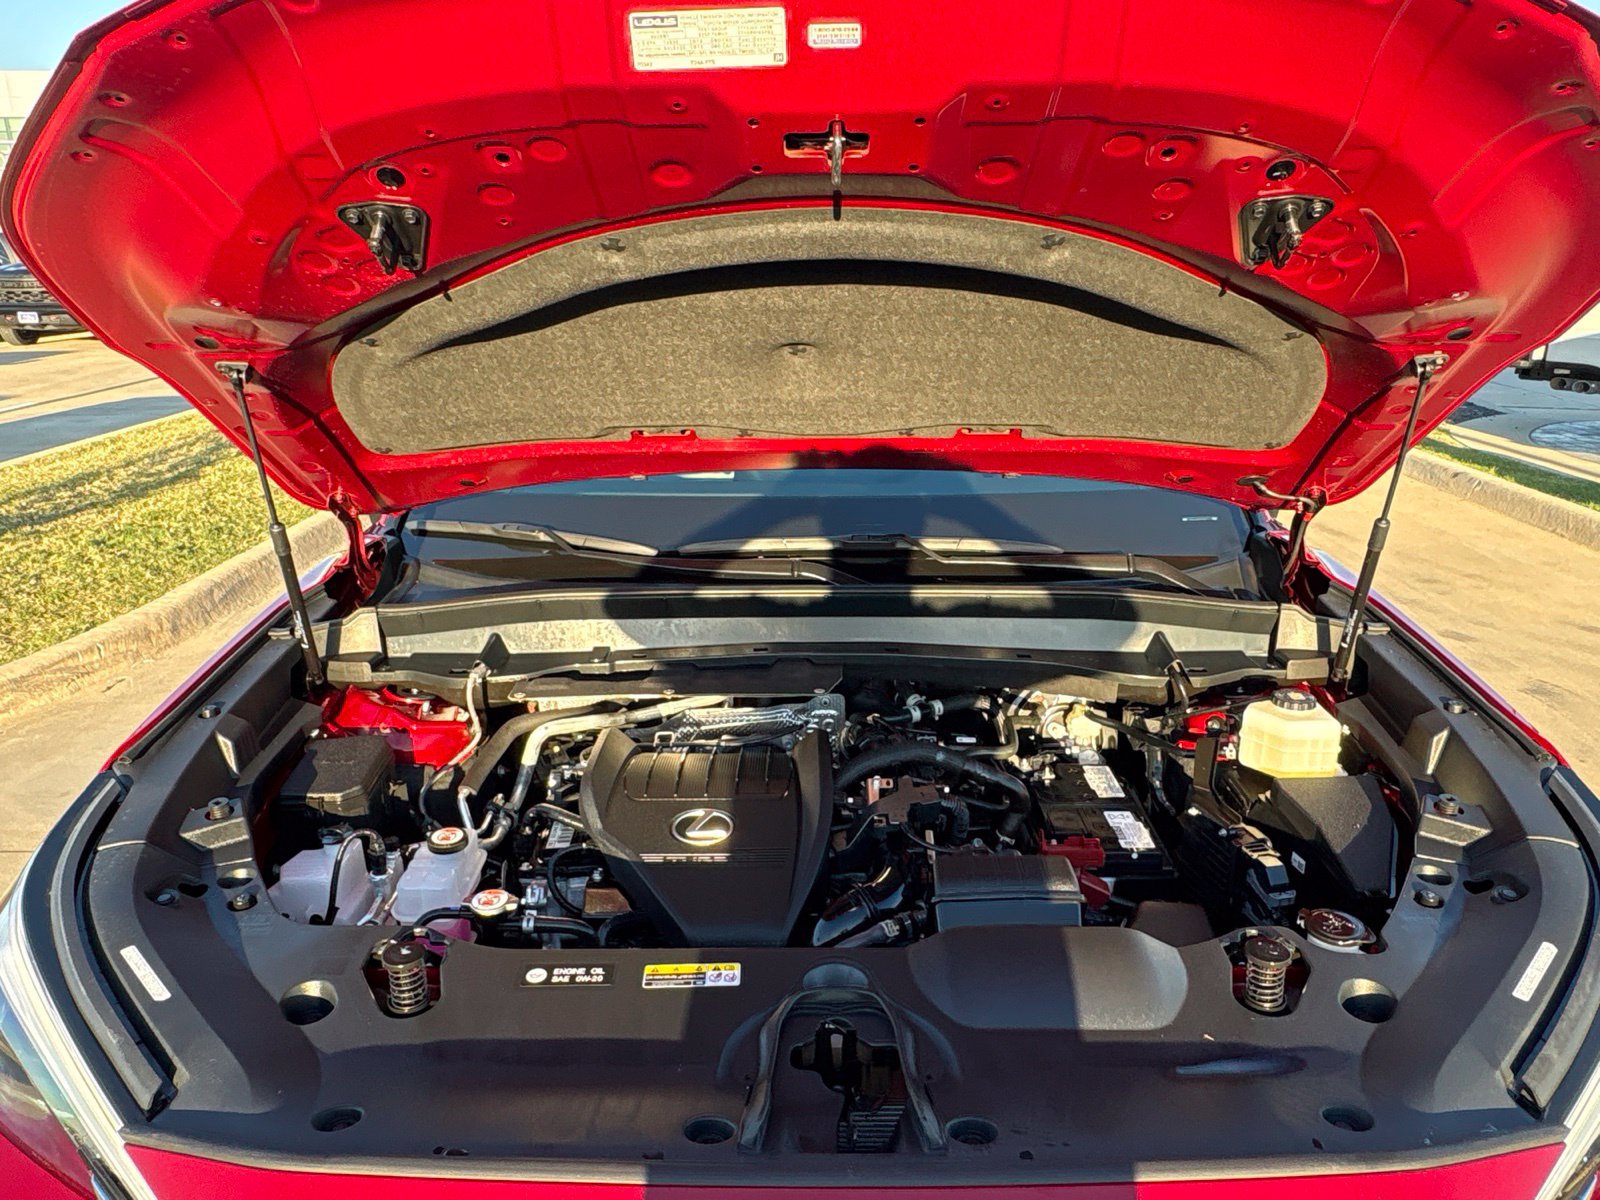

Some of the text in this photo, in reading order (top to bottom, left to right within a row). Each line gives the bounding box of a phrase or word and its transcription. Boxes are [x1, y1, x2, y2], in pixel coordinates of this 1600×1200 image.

[633, 17, 677, 27] LEXUS
[553, 967, 586, 975] ENGINE
[575, 975, 604, 983] 0W-20
